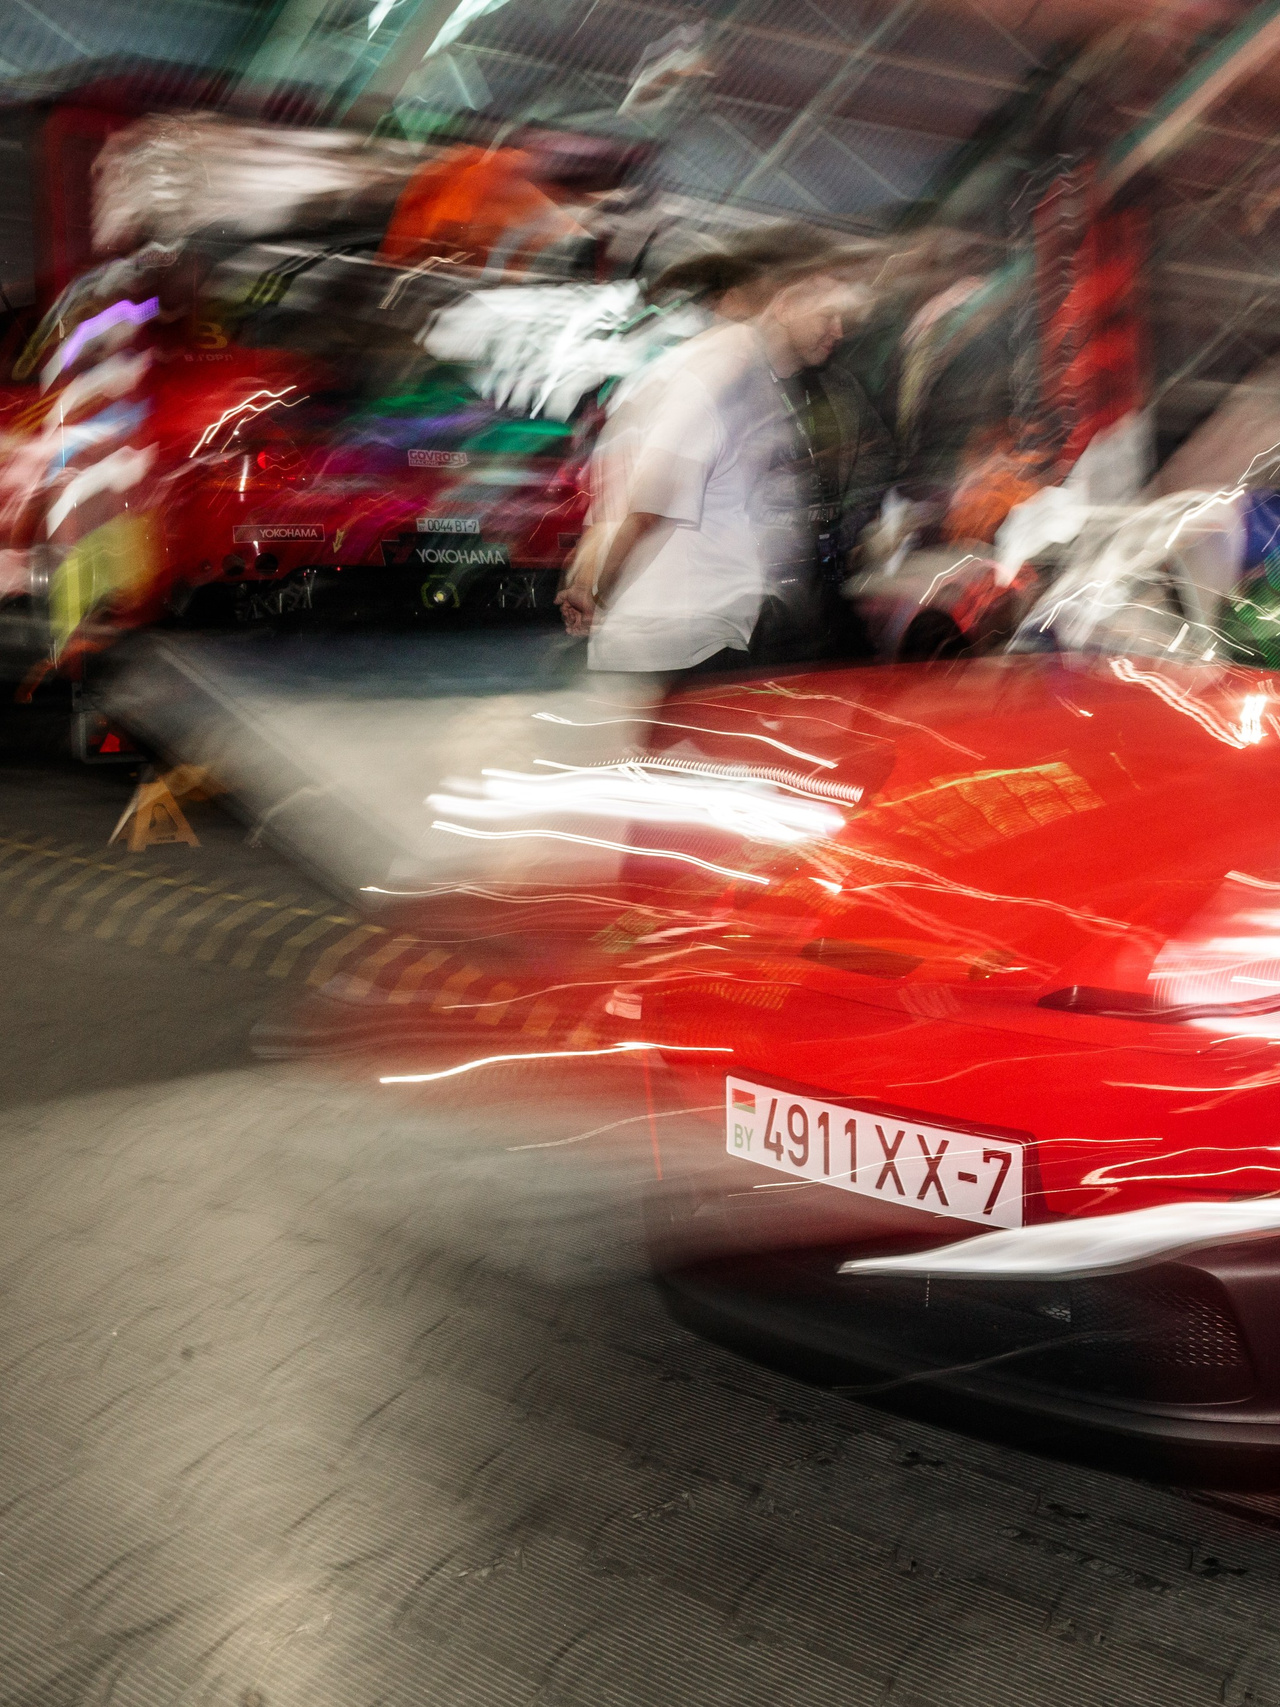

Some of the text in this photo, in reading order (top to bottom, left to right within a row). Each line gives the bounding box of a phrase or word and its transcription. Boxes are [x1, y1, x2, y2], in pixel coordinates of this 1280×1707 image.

[410, 451, 467, 464] GOVROCH
[427, 519, 453, 532] 0044
[260, 528, 318, 538] YOKOHAMA
[416, 549, 505, 565] YOKOHAMA
[734, 1123, 754, 1152] BY
